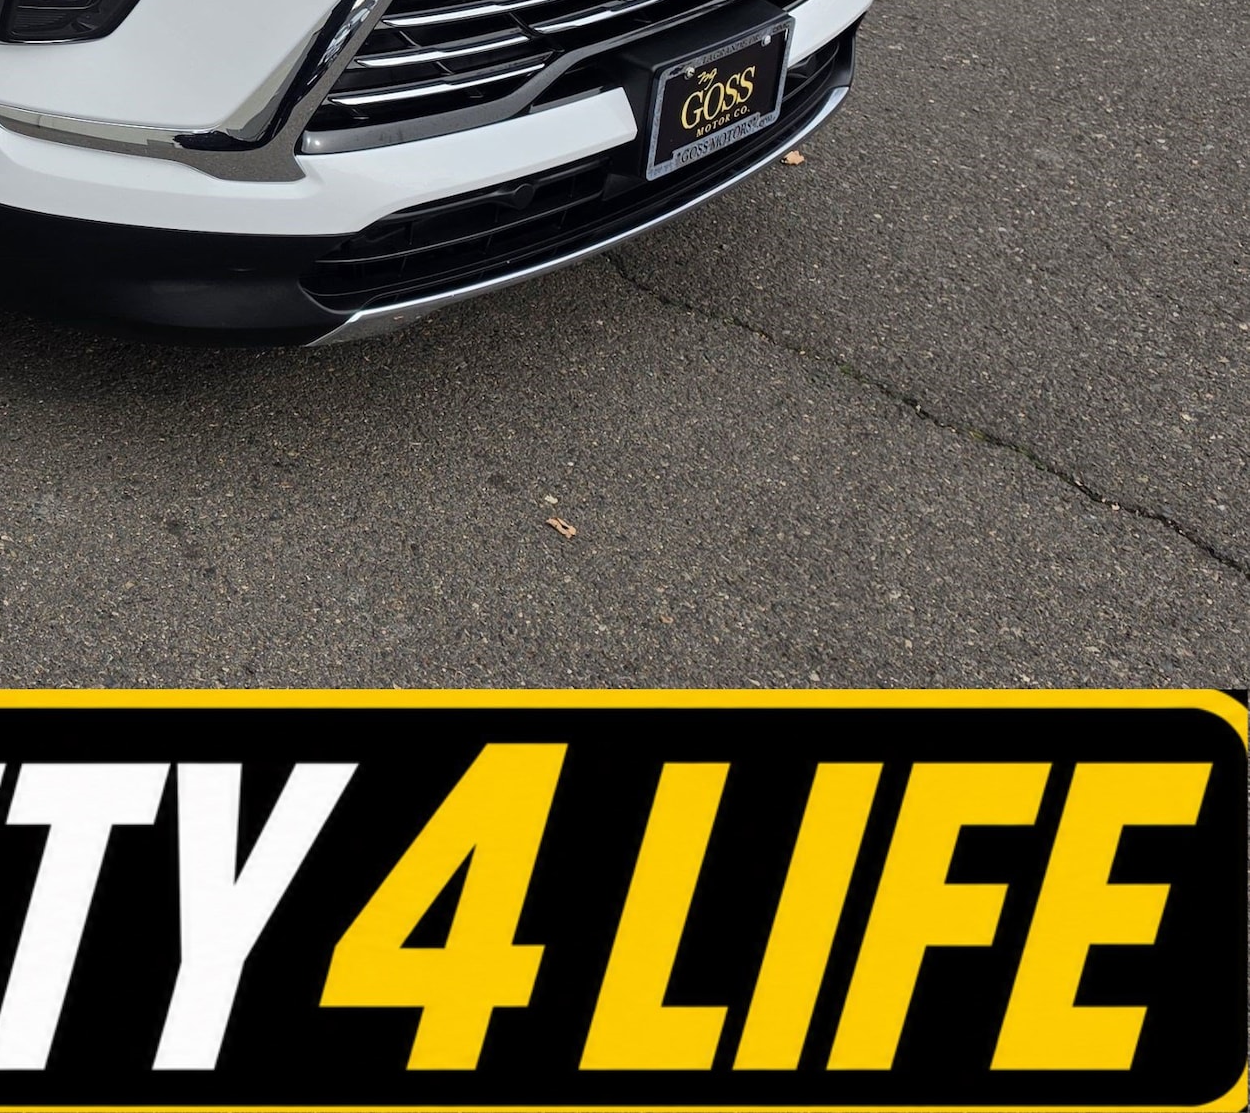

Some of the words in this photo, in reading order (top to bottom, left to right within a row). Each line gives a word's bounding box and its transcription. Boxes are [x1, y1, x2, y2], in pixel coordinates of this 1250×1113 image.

[682, 66, 755, 129] GOSS
[696, 114, 731, 138] MOTOR
[734, 105, 750, 117] CO.
